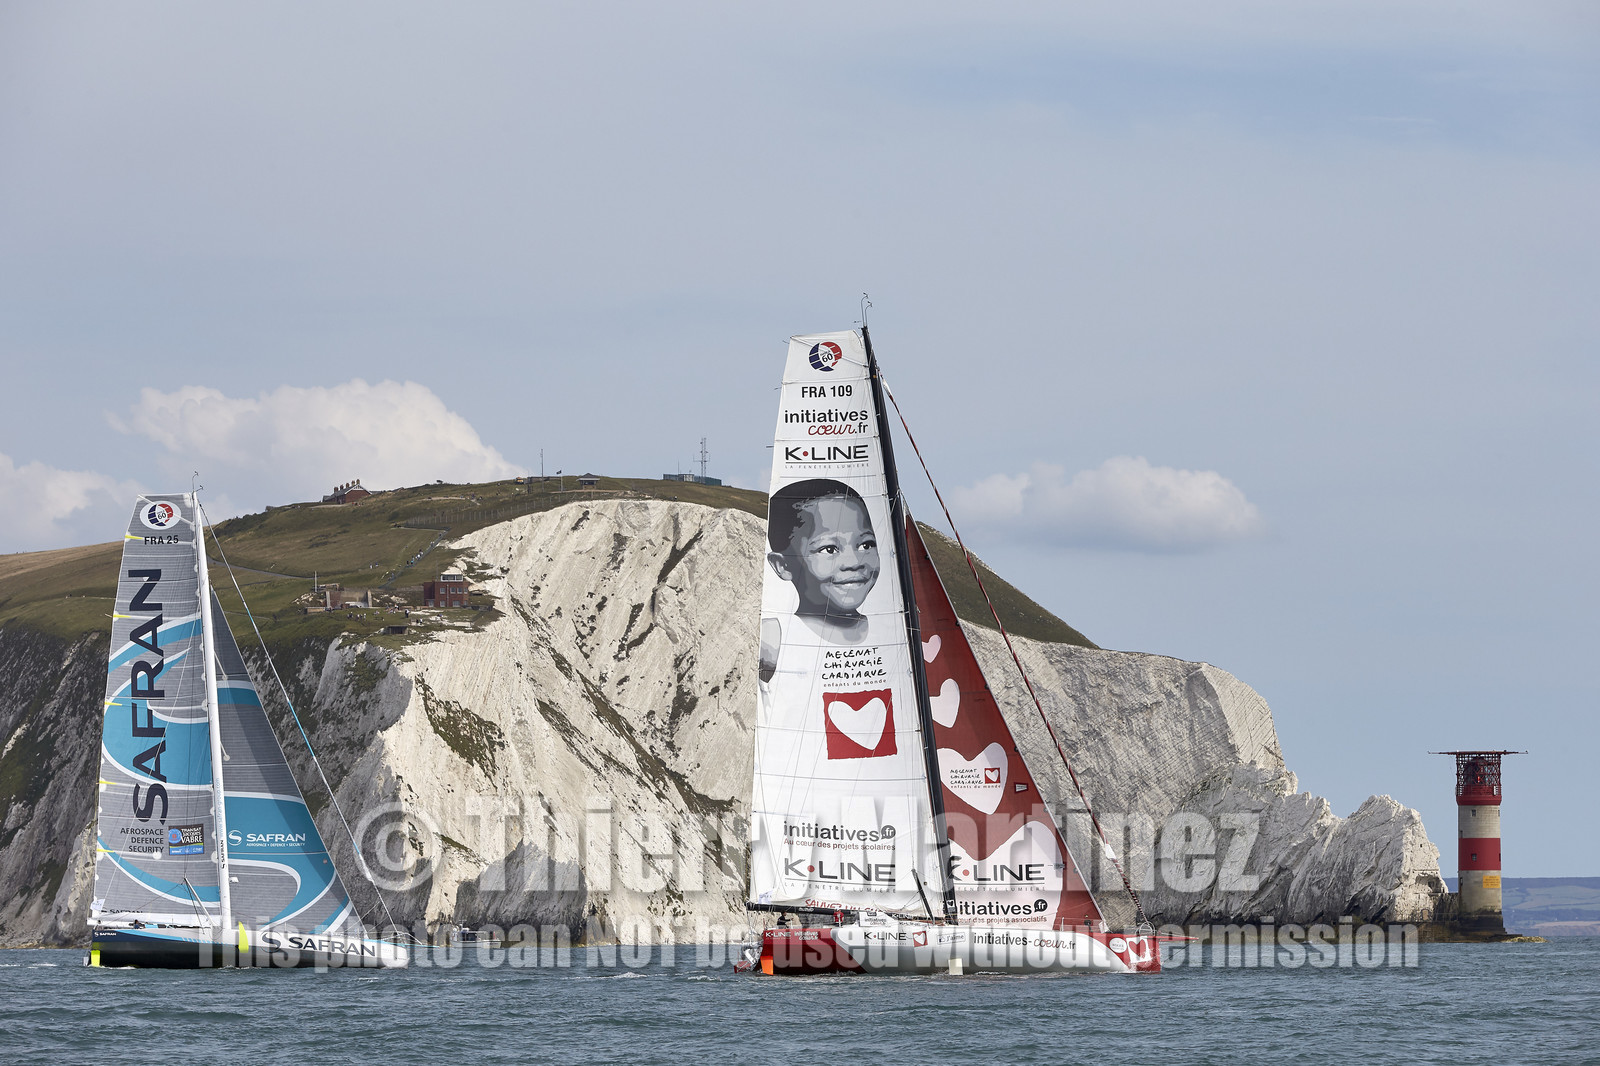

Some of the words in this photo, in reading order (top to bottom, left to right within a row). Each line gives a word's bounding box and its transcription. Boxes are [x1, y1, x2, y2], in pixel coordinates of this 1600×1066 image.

[822, 353, 833, 362] 60
[802, 386, 826, 398] FRA
[830, 385, 853, 397] 109
[784, 409, 868, 424] initiatives
[144, 536, 164, 545] FRA
[166, 535, 179, 544] 25
[128, 568, 168, 825] SAFRAN
[120, 828, 164, 836] AEROSPACE
[131, 836, 164, 844] DEFENCE
[181, 835, 202, 844] VABRE
[246, 833, 306, 842] SAFRAN
[128, 845, 164, 853] SECURITY
[817, 840, 831, 849] des
[832, 842, 860, 851] projets
[986, 916, 1010, 925] projets
[288, 936, 375, 956] SAFRAN
